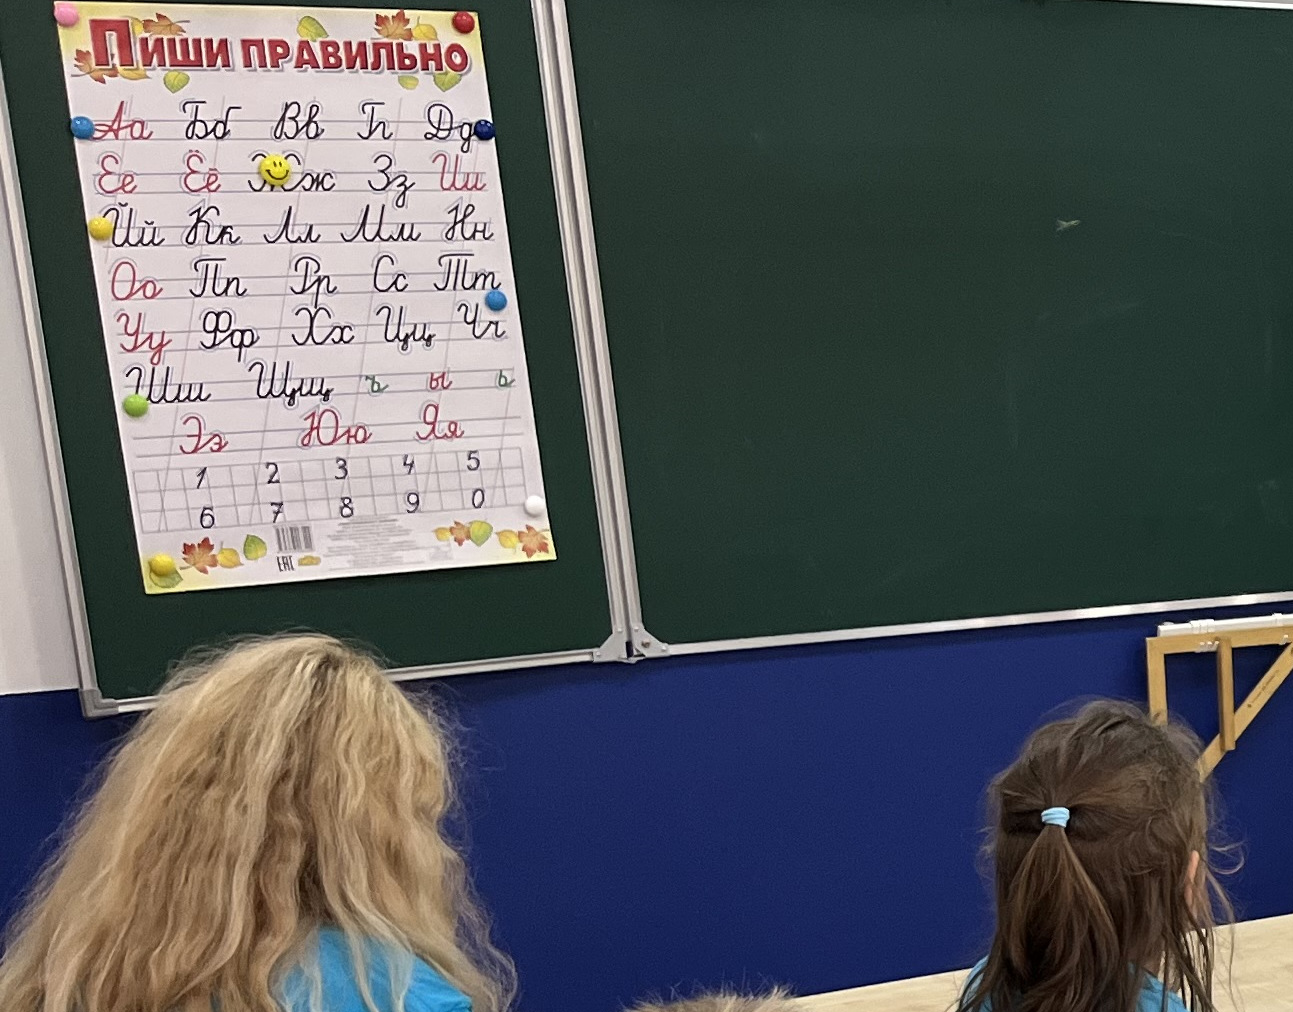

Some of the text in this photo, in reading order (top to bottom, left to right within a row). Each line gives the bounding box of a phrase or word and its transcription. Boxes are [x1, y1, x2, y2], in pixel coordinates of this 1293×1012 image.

[93, 101, 477, 153] Аа Бб Вв Гг Дд
[97, 154, 137, 194] Ее
[184, 149, 221, 194] Ёё
[367, 154, 415, 207] Зз
[433, 153, 487, 192] Ии
[102, 203, 494, 247] Йй Кк Лл Мм Нн
[110, 254, 502, 309] Оо Пп Рр Сс Тт
[117, 303, 506, 365] Уу Фф Хх Цц Чч
[125, 361, 516, 406] Шш Щщ ъ ы ь
[180, 403, 464, 454] Ээ Юю Яя
[196, 449, 481, 489] 1 2 3 4 5
[199, 488, 485, 529] 6 7 8 9 0
